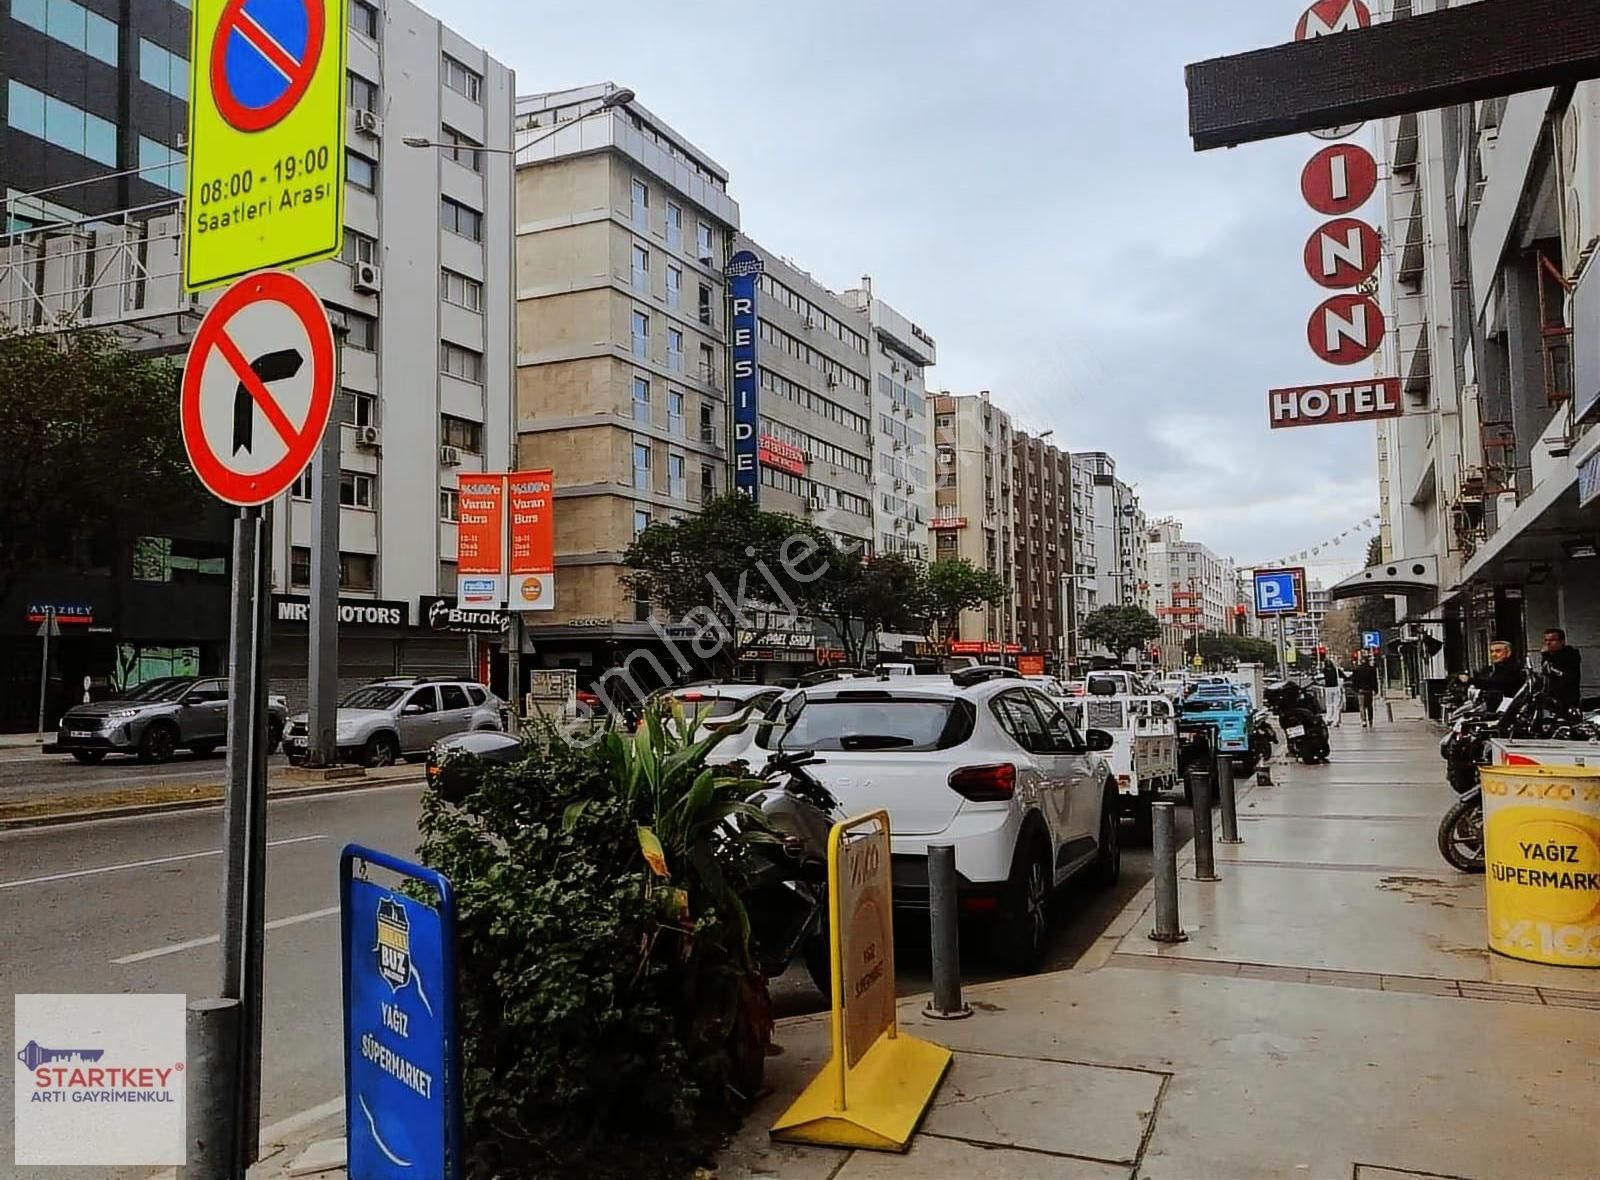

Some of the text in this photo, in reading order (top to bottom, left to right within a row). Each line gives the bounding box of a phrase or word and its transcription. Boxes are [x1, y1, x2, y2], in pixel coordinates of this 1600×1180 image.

[200, 169, 253, 206] 08:00
[274, 145, 329, 184] 19:00
[197, 182, 330, 234] Saatleri Arası
[1273, 382, 1396, 420] HOTEL
[512, 498, 545, 510] Varan
[1260, 580, 1280, 608] P
[278, 602, 400, 624] MR OTORS
[1519, 840, 1580, 863] YAĞIZ
[381, 945, 406, 975] BUZ
[381, 1001, 409, 1039] YAĞIZ
[361, 1032, 433, 1100] SÜPERMARKET
